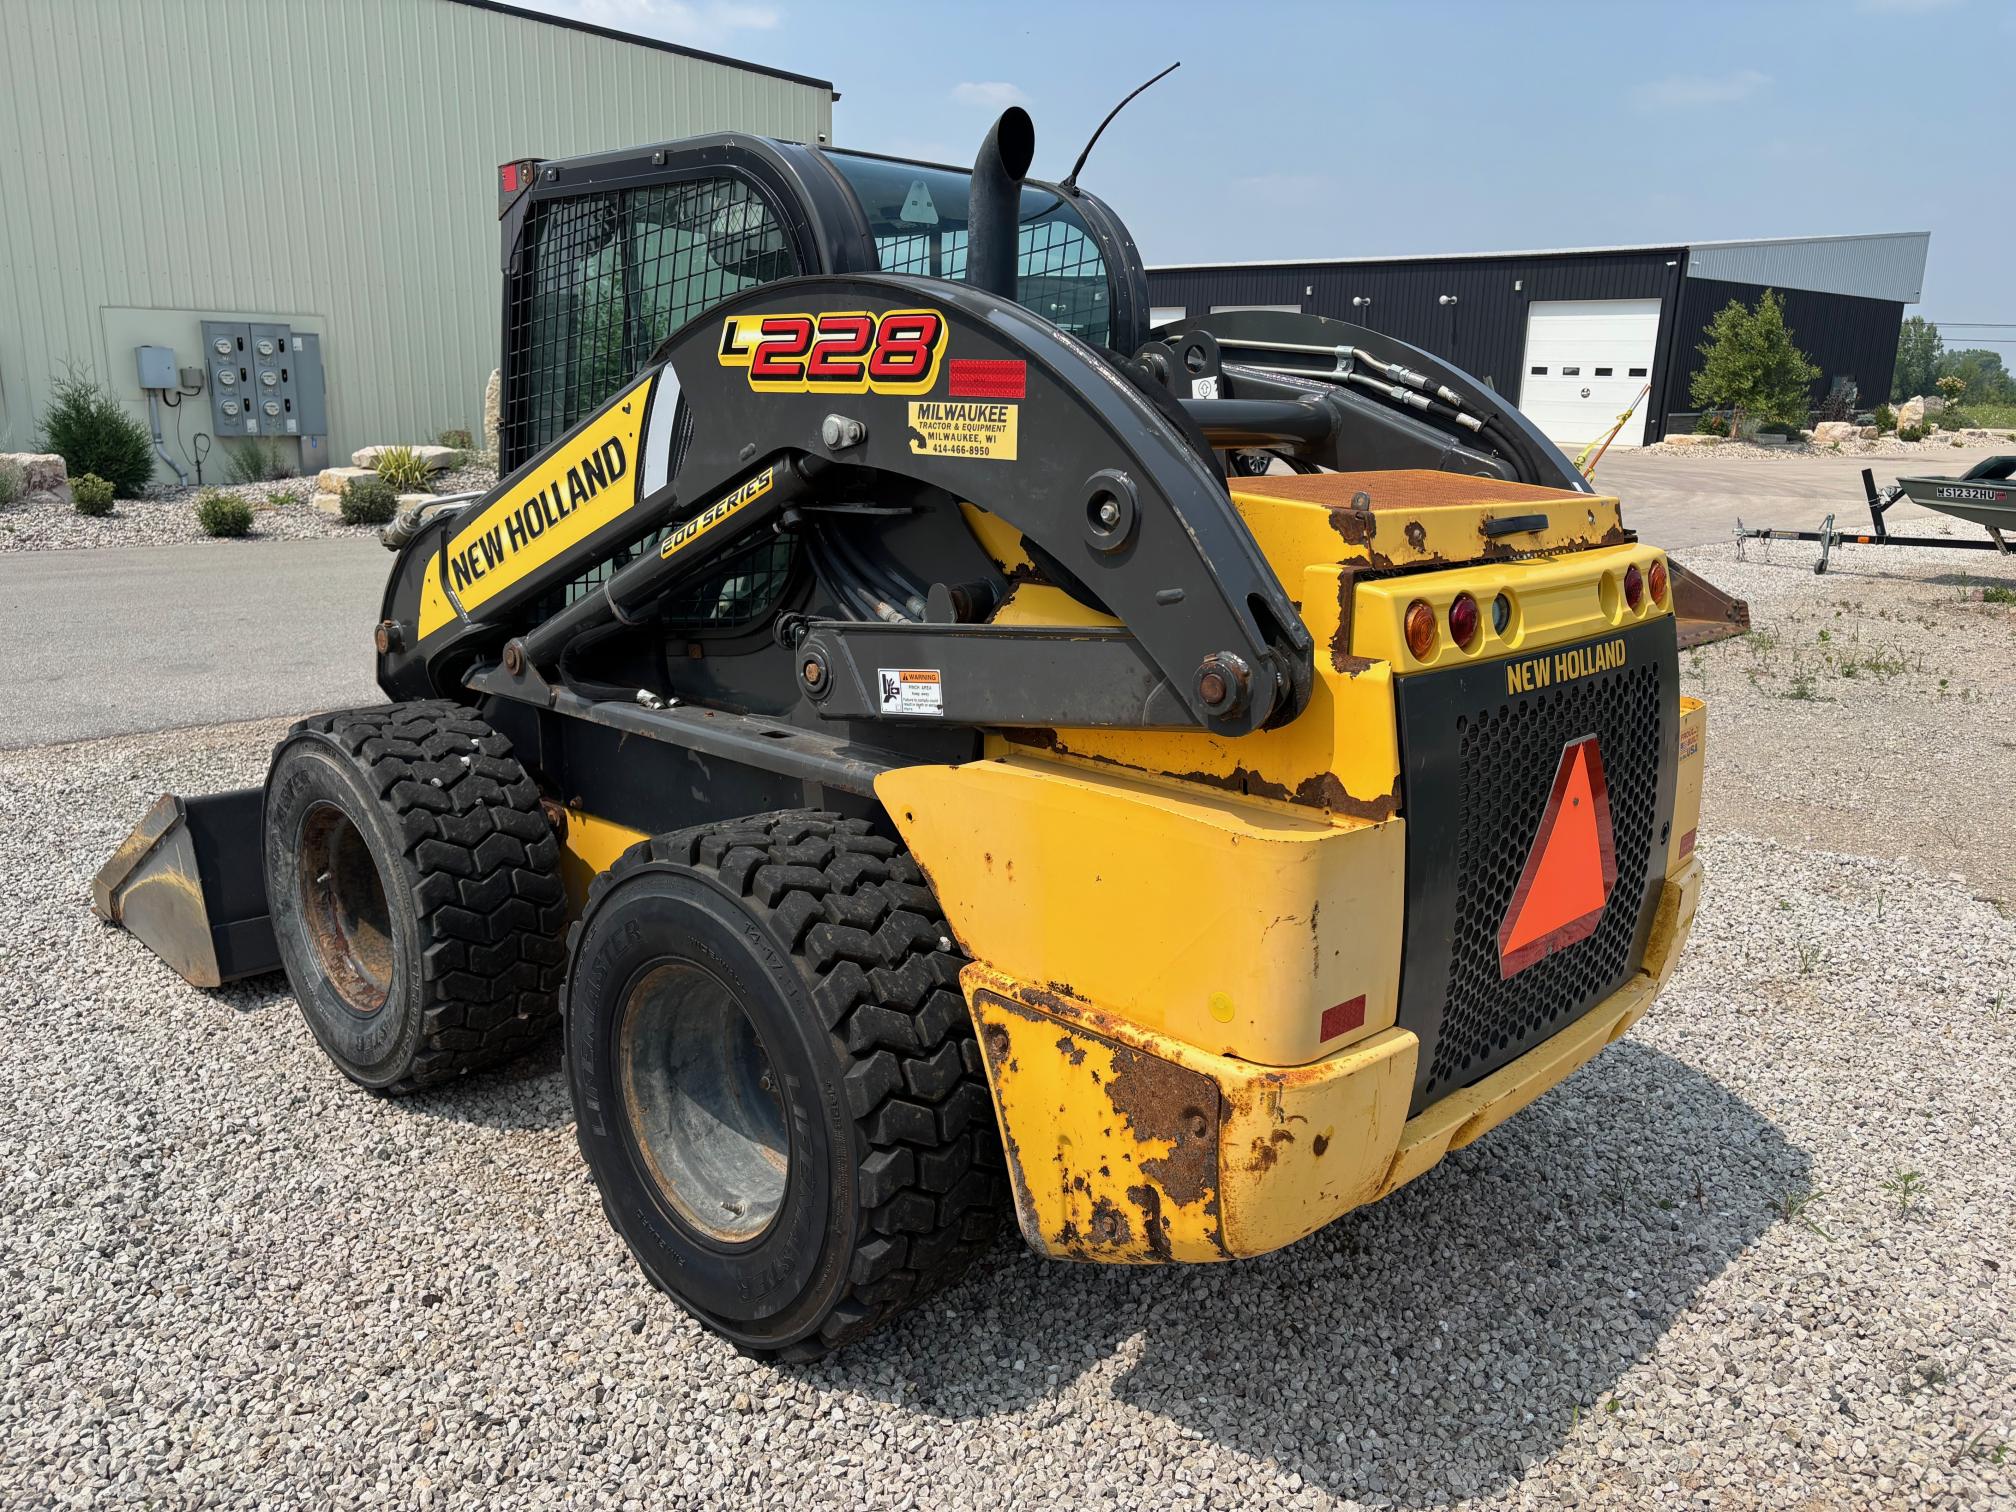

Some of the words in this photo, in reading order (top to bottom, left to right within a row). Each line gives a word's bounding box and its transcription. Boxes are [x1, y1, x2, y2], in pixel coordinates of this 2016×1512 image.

[719, 315, 944, 383] L228
[917, 403, 1009, 424] MILWAUKEE
[919, 422, 951, 432] TRACTOR
[953, 423, 960, 431] &
[962, 423, 1007, 433] EQUIPMENT
[927, 432, 982, 444] MILWAUKEE,
[985, 434, 997, 444] WI
[932, 444, 990, 456] 414-466-8950
[451, 519, 505, 592] NEW
[504, 435, 627, 554] HOLLAND
[663, 521, 698, 554] 200
[703, 471, 771, 528] SERIES
[1507, 656, 1550, 695] NEW
[1555, 639, 1626, 684] HOLLAND
[1687, 743, 1698, 757] USA
